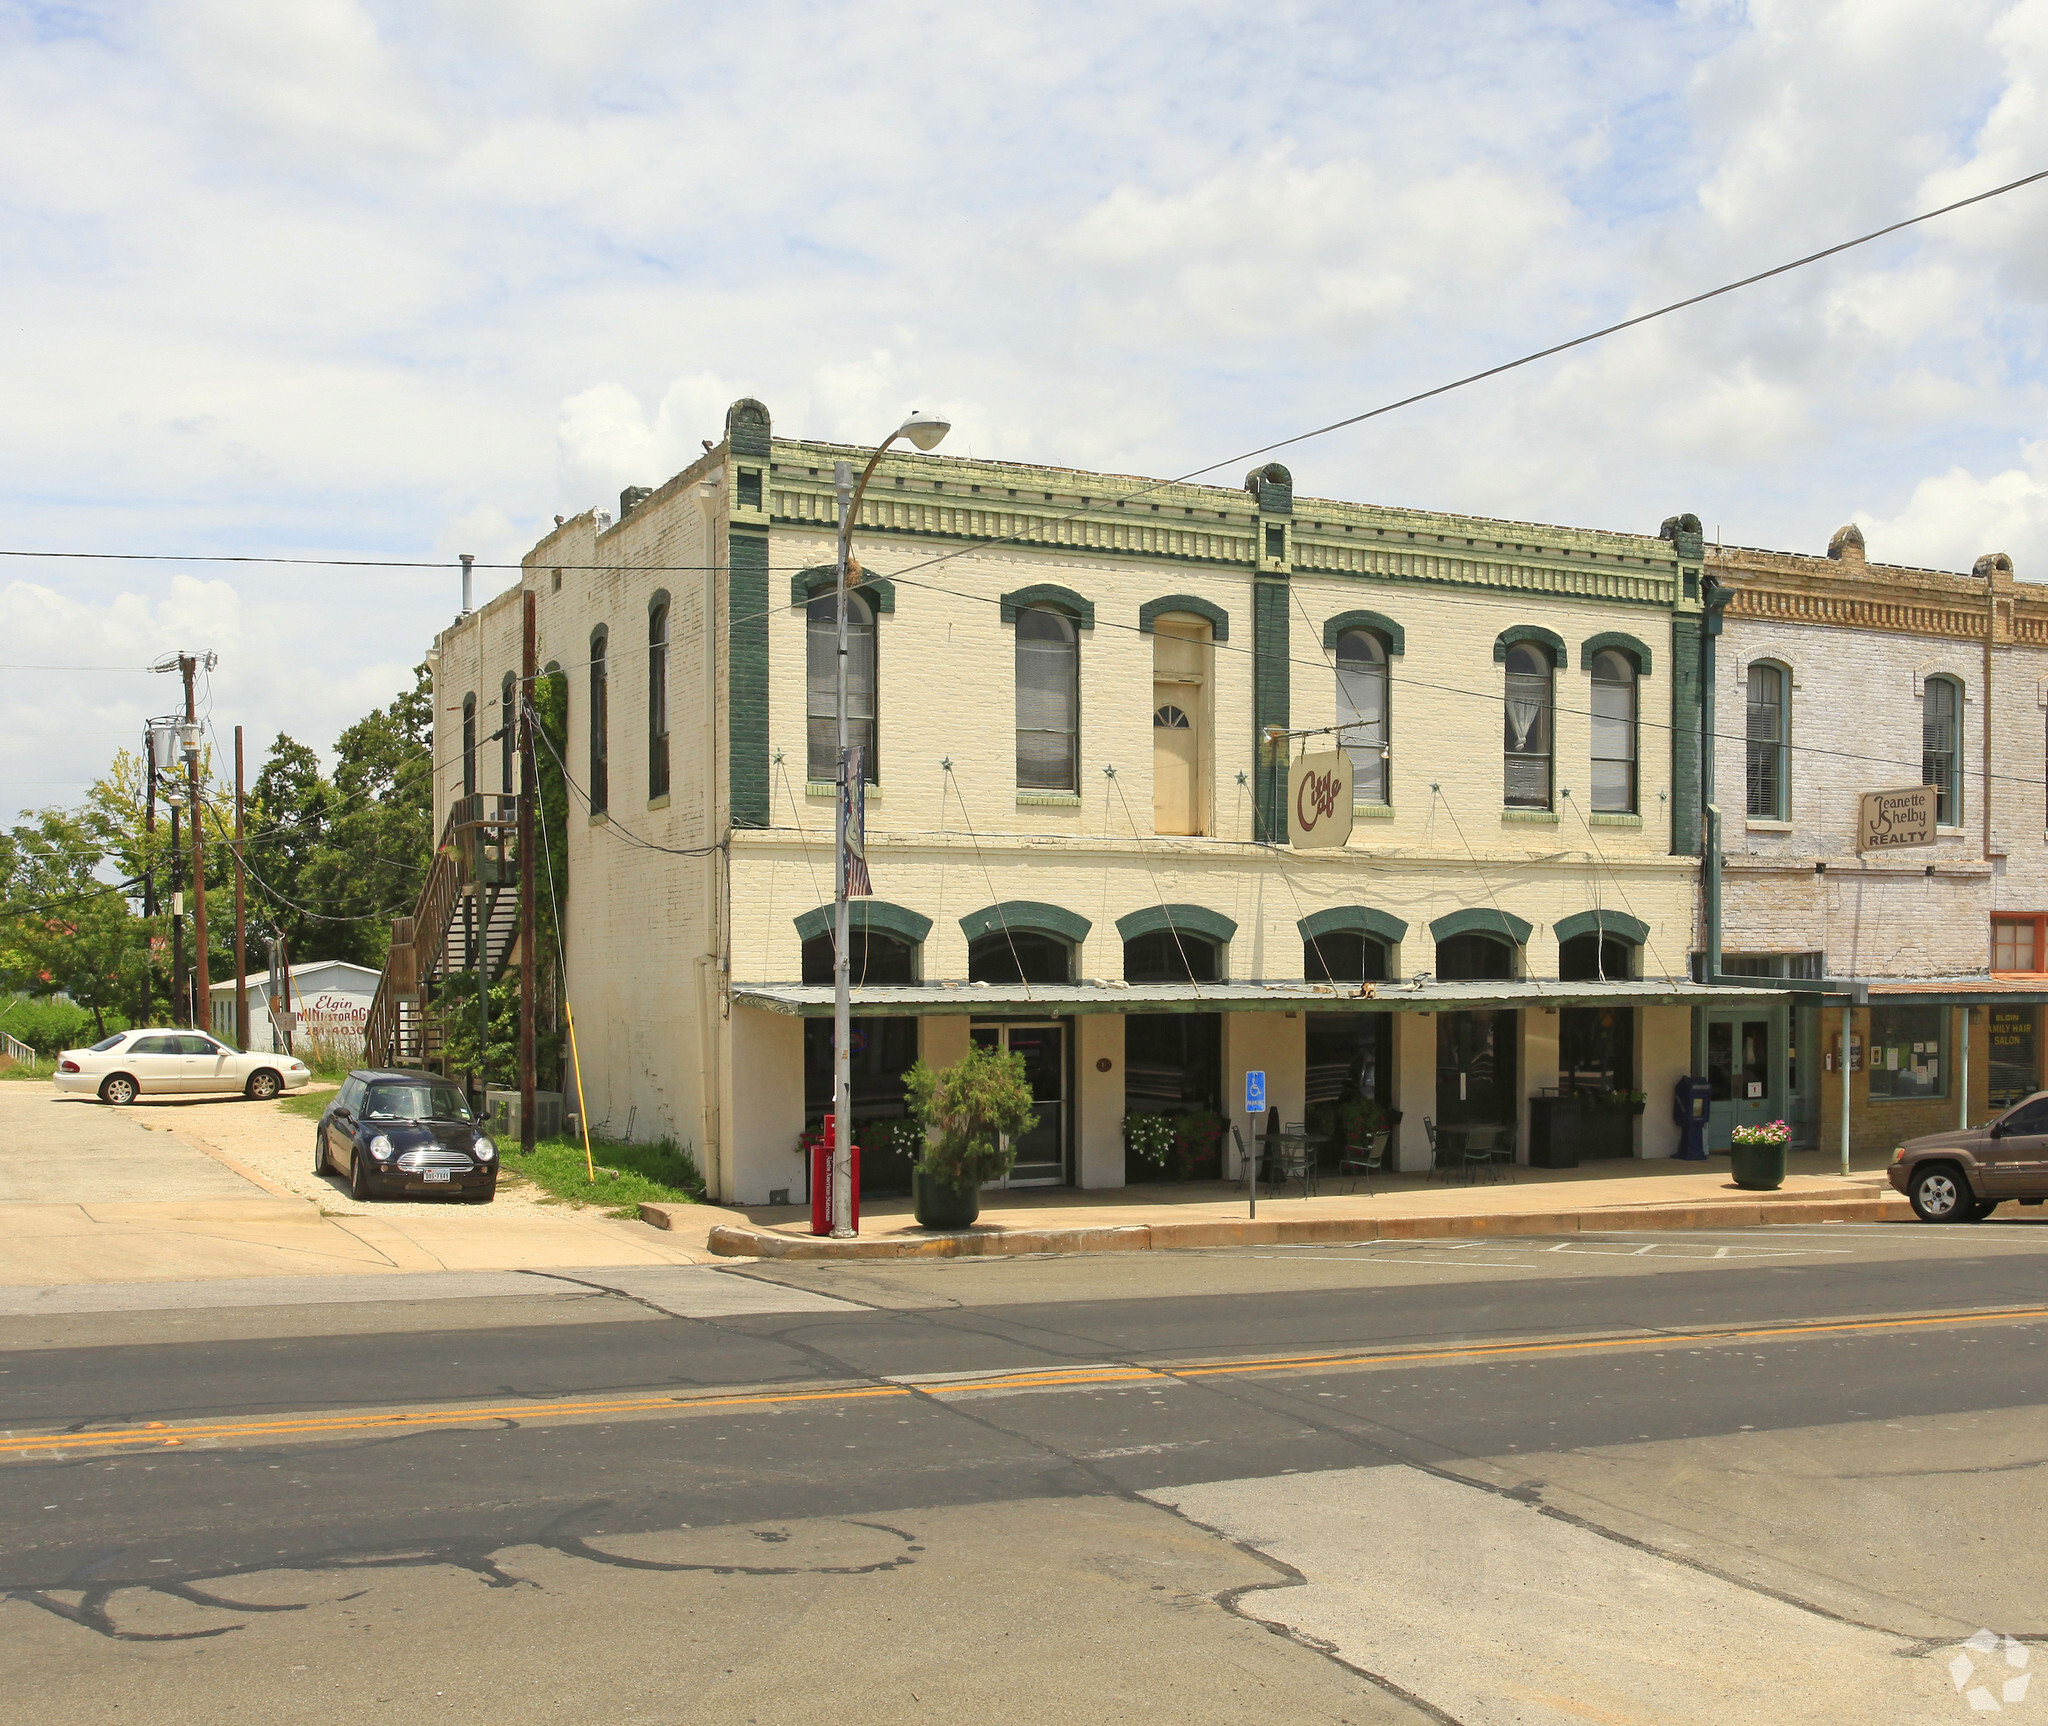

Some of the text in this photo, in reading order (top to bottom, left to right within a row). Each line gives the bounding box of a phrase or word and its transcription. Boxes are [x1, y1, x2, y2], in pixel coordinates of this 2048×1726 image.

[1870, 794, 1925, 829] Jeanette
[1872, 809, 1926, 835] Shelby
[1870, 831, 1928, 846] REALTY
[315, 995, 352, 1012] Elgin
[297, 1007, 323, 1021] MINI
[1989, 1023, 2032, 1033] AMILY HAIR
[1994, 1035, 2021, 1045] SALON
